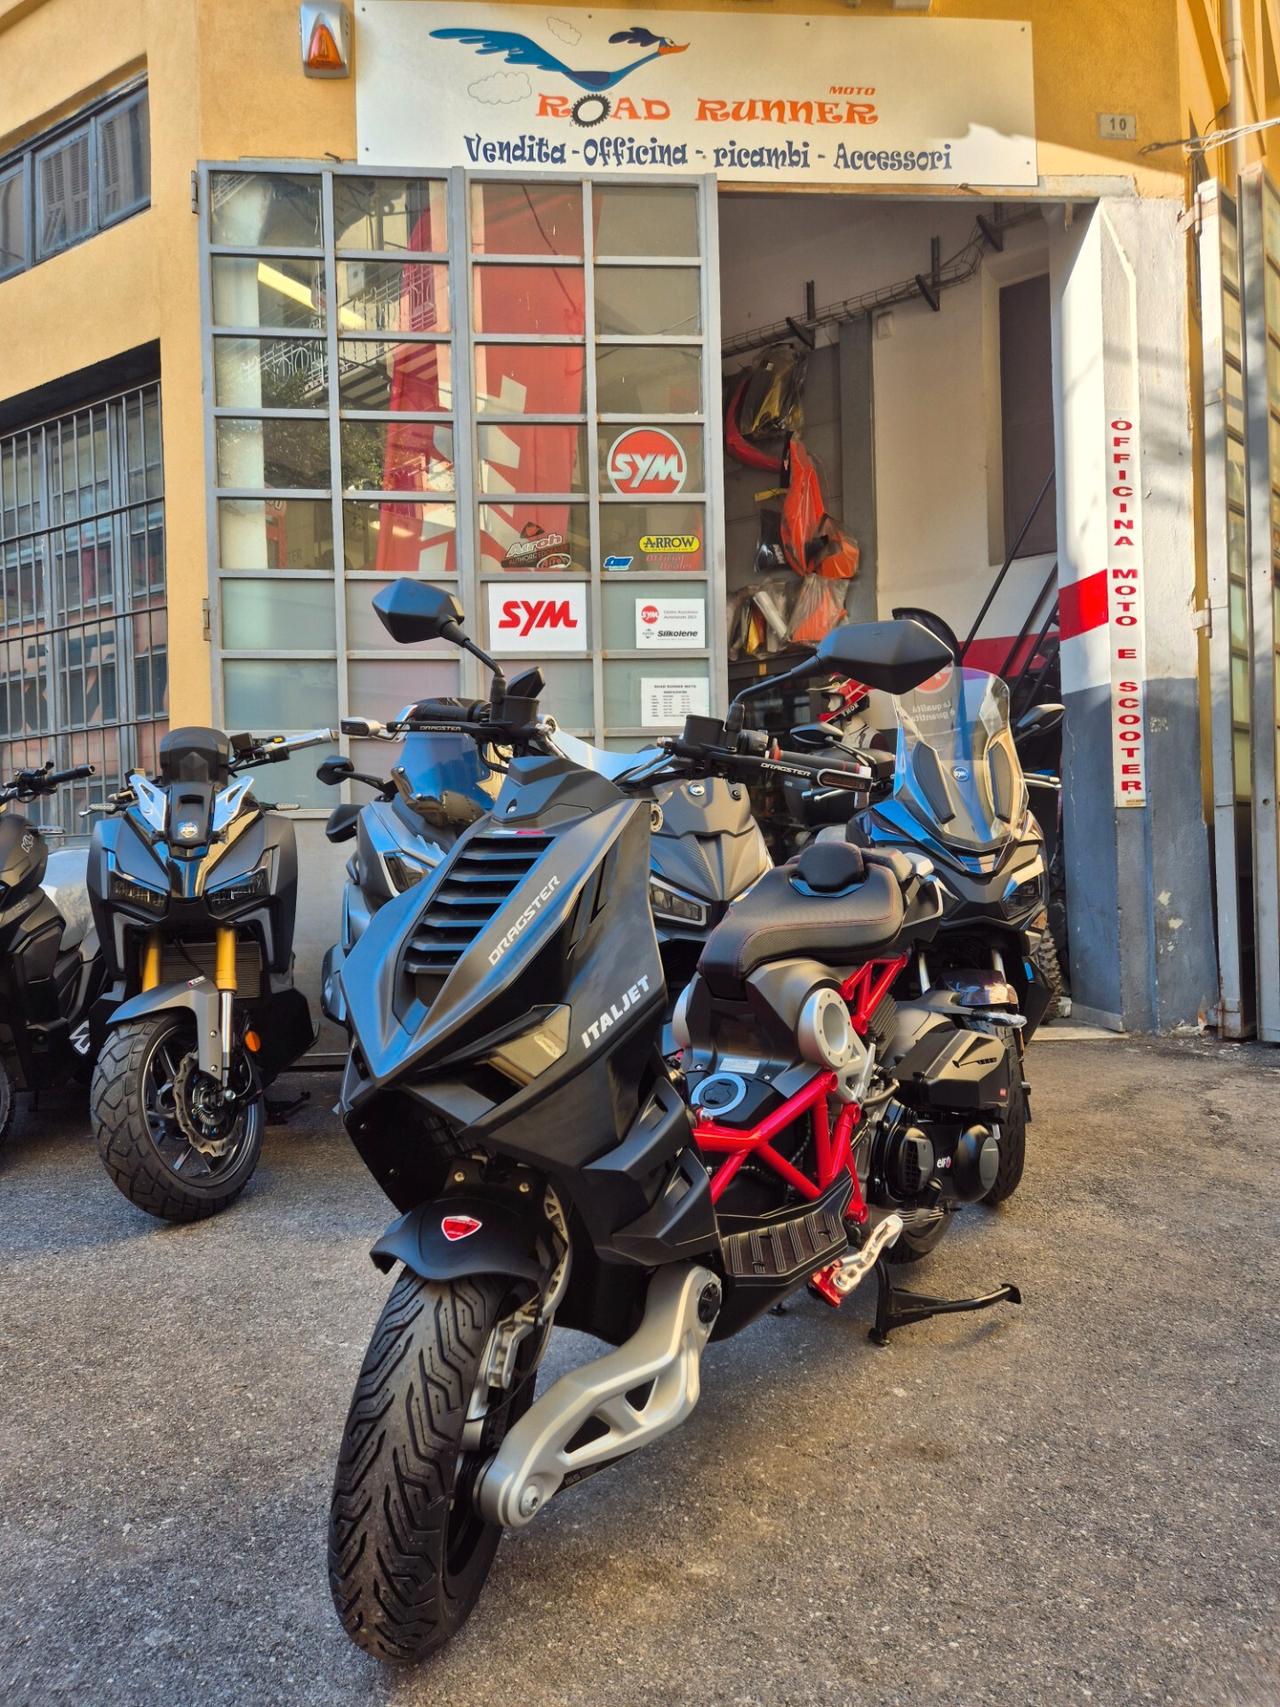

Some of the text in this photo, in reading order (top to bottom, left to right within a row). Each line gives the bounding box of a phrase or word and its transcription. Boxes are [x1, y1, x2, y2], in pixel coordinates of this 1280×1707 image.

[829, 86, 876, 96] MOTO
[535, 92, 879, 128] ROAD RUNNER
[1110, 117, 1127, 131] 10
[463, 132, 567, 164] Vendita
[583, 136, 688, 167] Officina
[714, 140, 811, 170] ricambi
[833, 142, 952, 171] Accessori
[607, 453, 685, 488] SYM
[1111, 420, 1134, 546] OFFICINA
[643, 537, 695, 549] ARROW
[1112, 569, 1138, 626] MOTO
[498, 600, 578, 637] SYM
[1118, 649, 1137, 659] E
[1118, 681, 1142, 791] SCOOTER
[760, 762, 812, 777] DRAGSTER
[488, 875, 561, 966] DRAGSTER
[580, 975, 650, 1049] ITALJET
